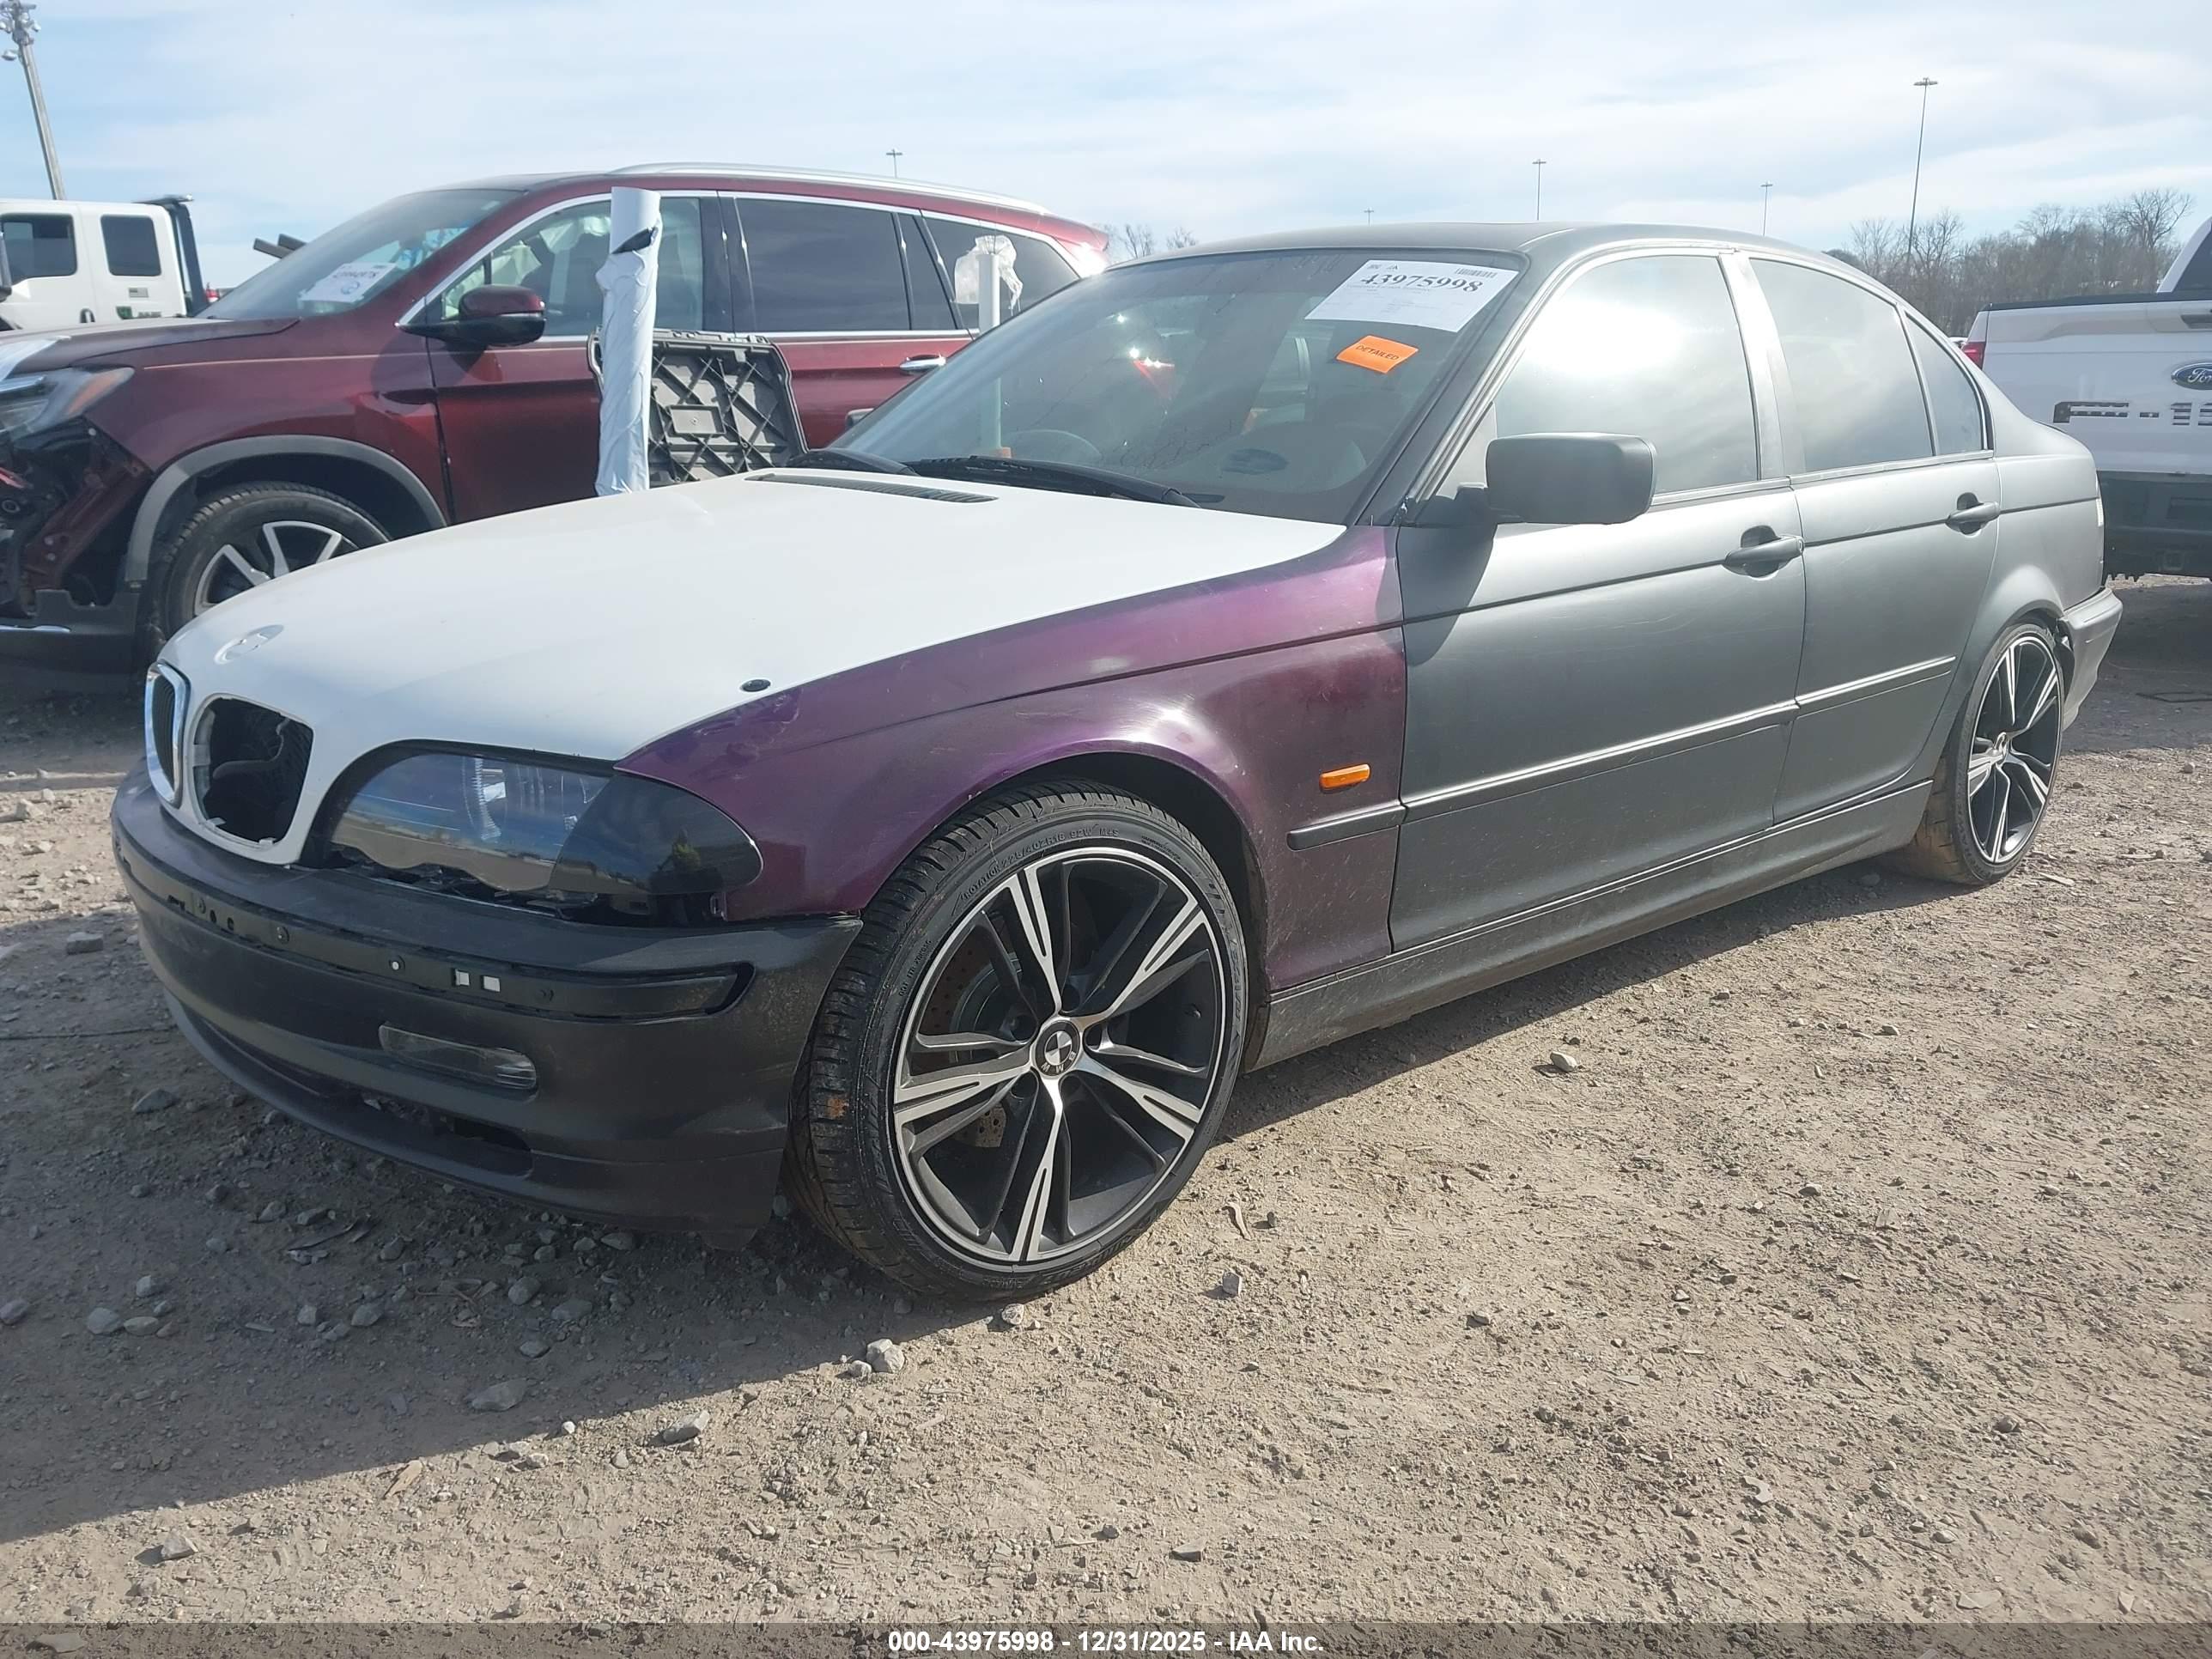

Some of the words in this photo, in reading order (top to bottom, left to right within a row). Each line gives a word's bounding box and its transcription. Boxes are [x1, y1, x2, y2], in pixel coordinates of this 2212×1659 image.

[1360, 273, 1484, 293] 43975998
[1355, 344, 1400, 361] DETAILED
[2187, 368, 2212, 384] For
[2053, 400, 2212, 427] F-1
[1041, 1050, 1077, 1073] BMW
